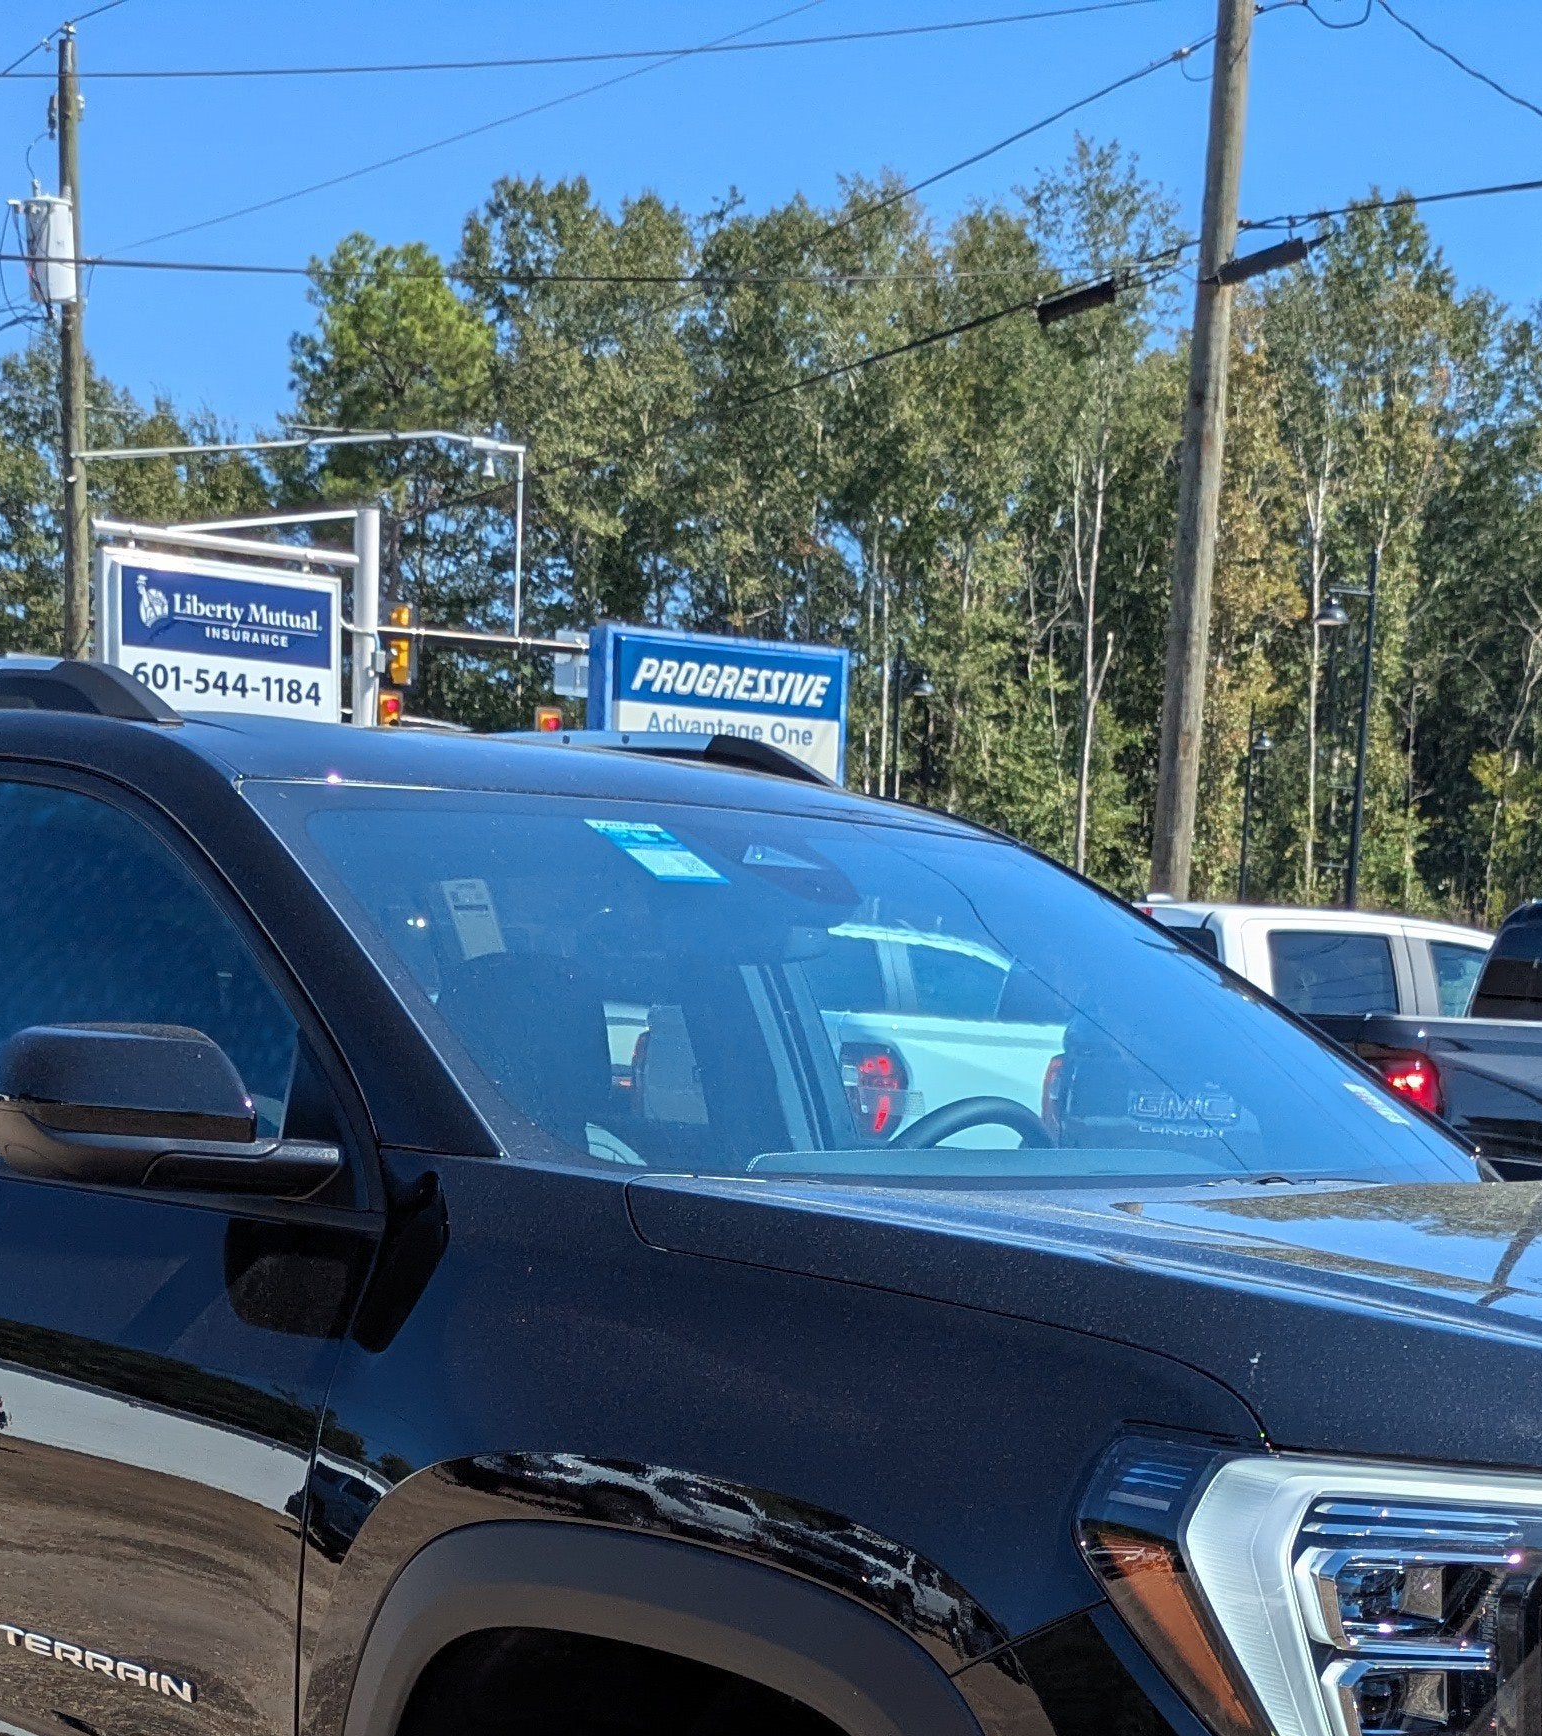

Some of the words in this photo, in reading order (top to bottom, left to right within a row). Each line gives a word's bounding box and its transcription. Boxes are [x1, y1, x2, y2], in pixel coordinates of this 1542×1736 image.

[173, 592, 244, 628] Liberty
[204, 625, 289, 648] INSURANCE
[133, 661, 322, 707] 601-544-1184
[630, 657, 832, 708] PROGRESSIVE
[646, 711, 763, 741] Advantage
[770, 721, 813, 747] One
